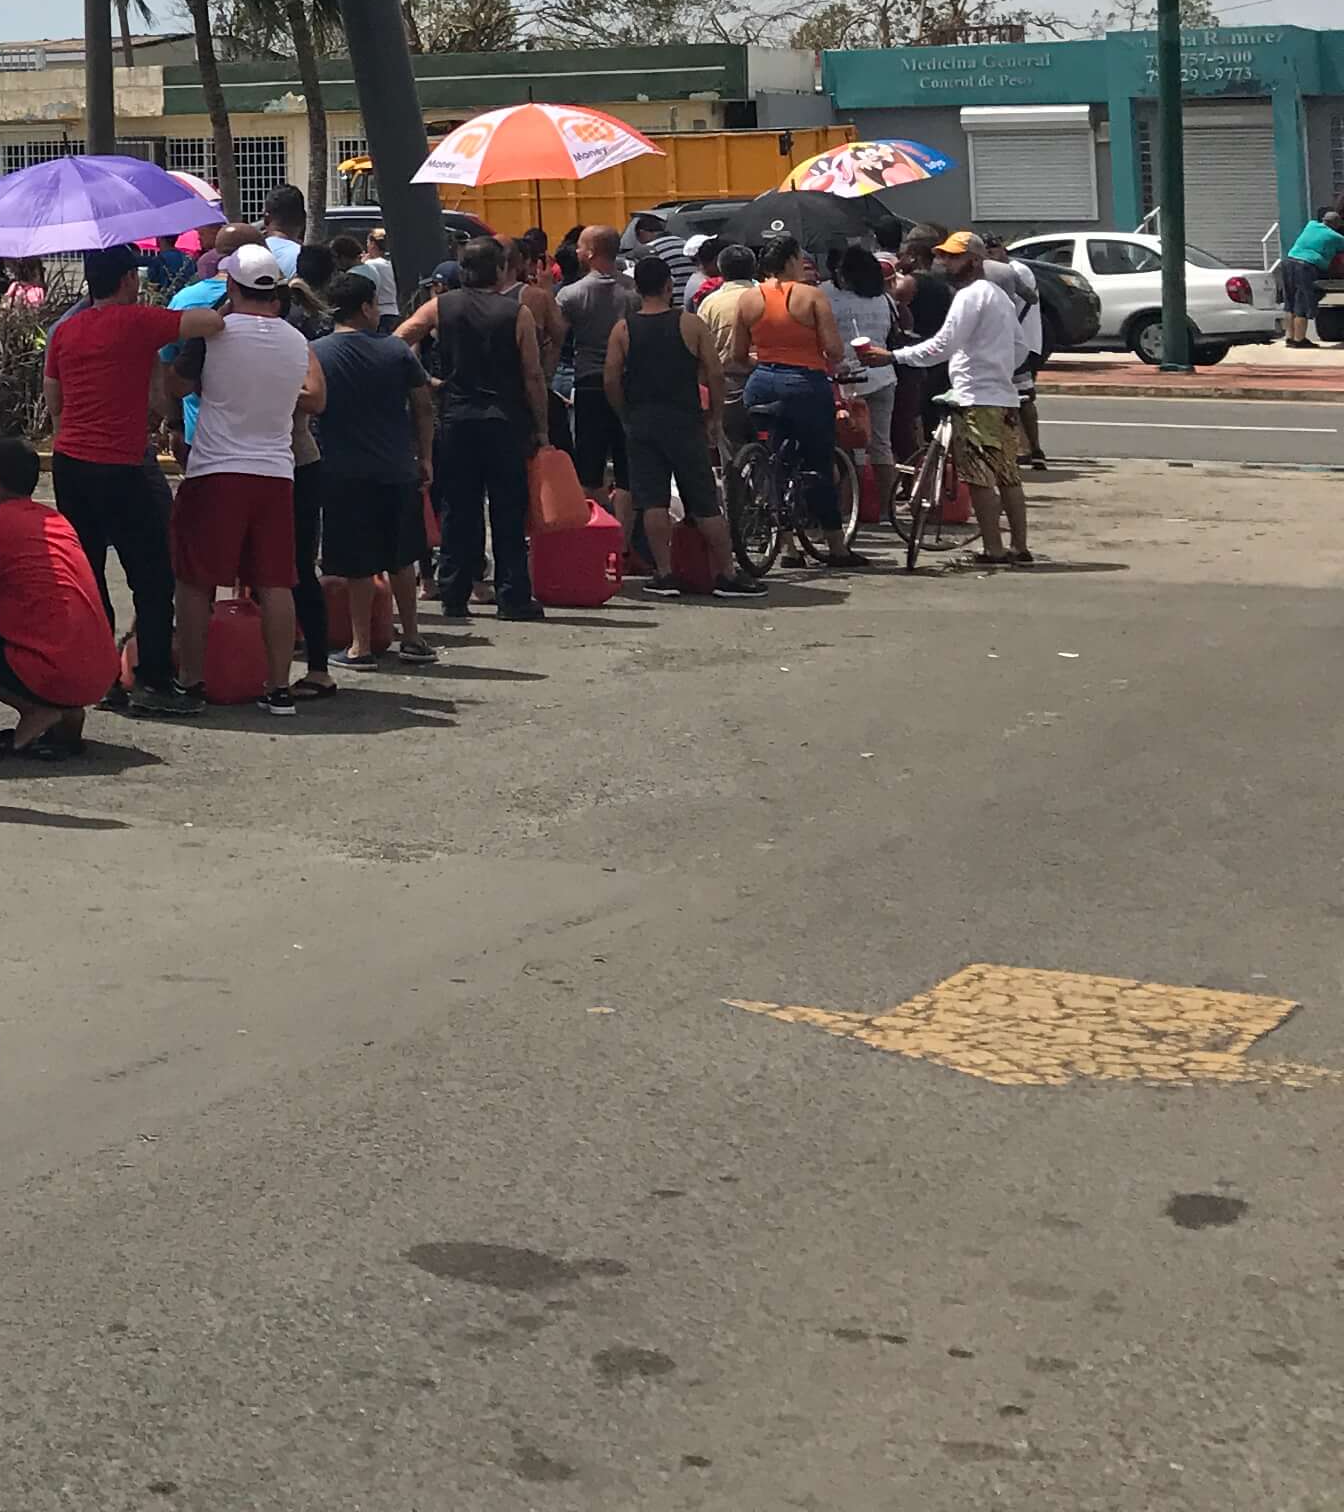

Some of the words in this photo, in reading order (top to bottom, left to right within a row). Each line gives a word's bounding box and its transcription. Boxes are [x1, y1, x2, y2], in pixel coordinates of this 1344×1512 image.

[902, 56, 976, 71] Medicina
[983, 53, 1051, 69] General
[919, 73, 974, 89] Control
[978, 73, 995, 87] de
[572, 146, 608, 162] Money
[426, 160, 456, 170] Money
